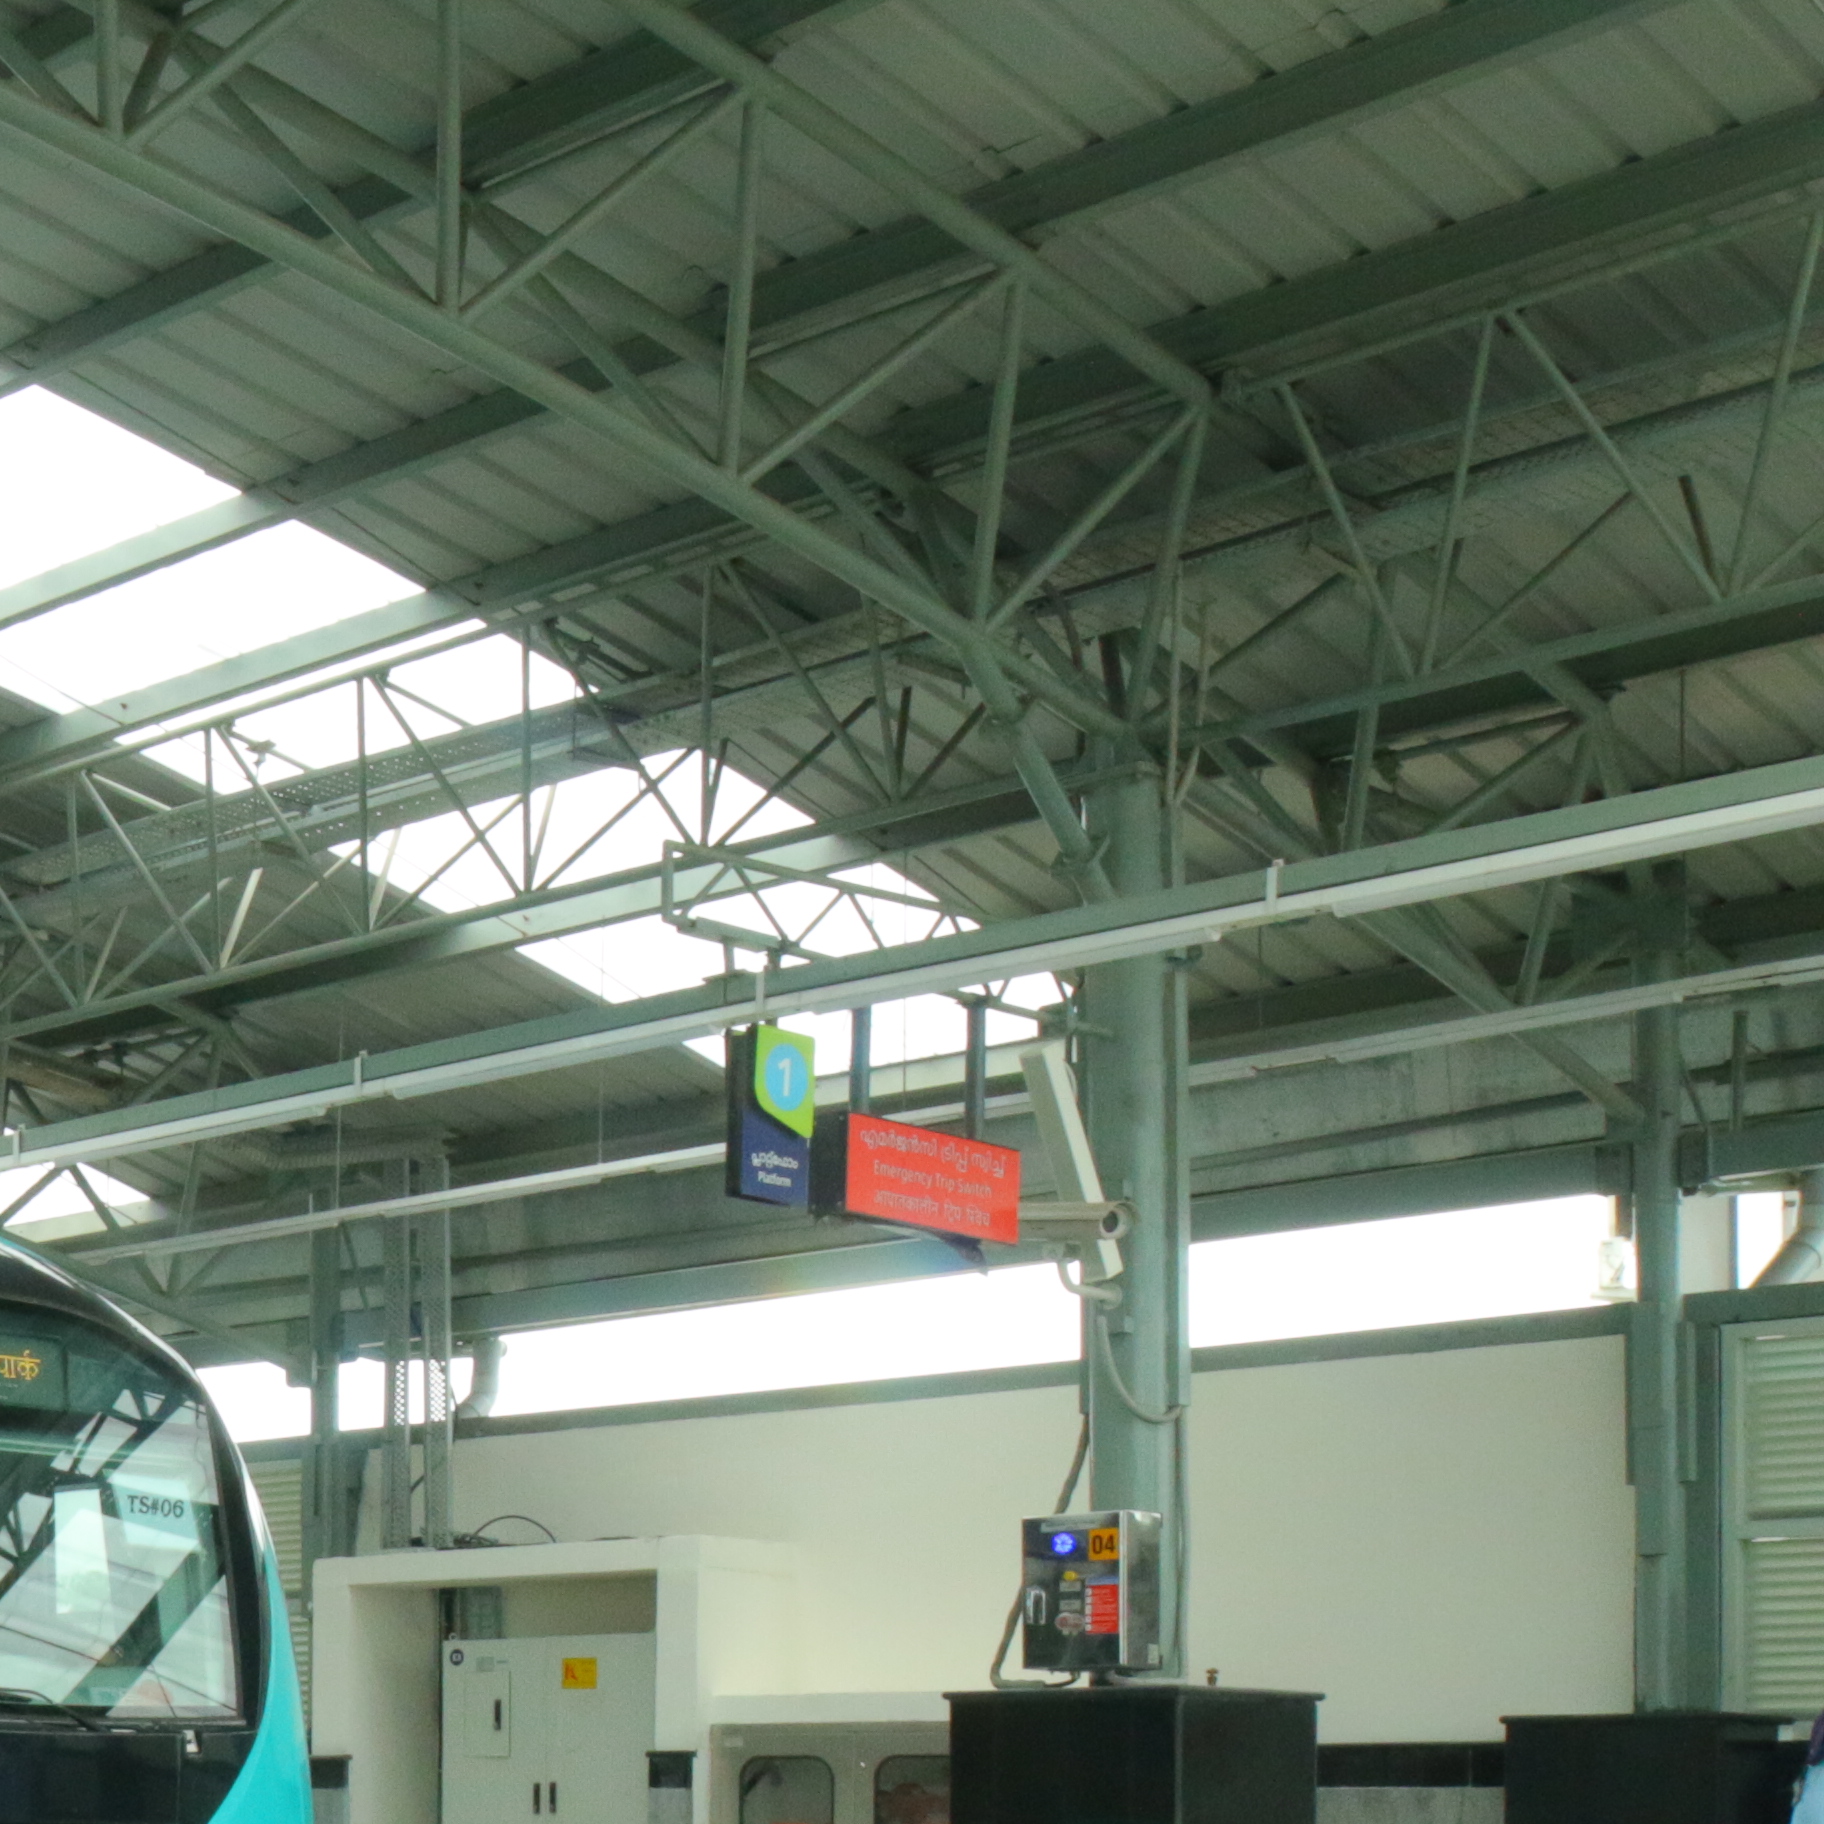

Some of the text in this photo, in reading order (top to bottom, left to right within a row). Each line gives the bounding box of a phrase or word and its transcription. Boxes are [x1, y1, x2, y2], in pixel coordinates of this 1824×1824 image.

[778, 1058, 792, 1097] 1
[757, 1171, 792, 1187] Platform
[873, 1160, 992, 1198] Emergency Trip Switch
[127, 1495, 185, 1518] TS#06
[1091, 1534, 1115, 1554] 04
